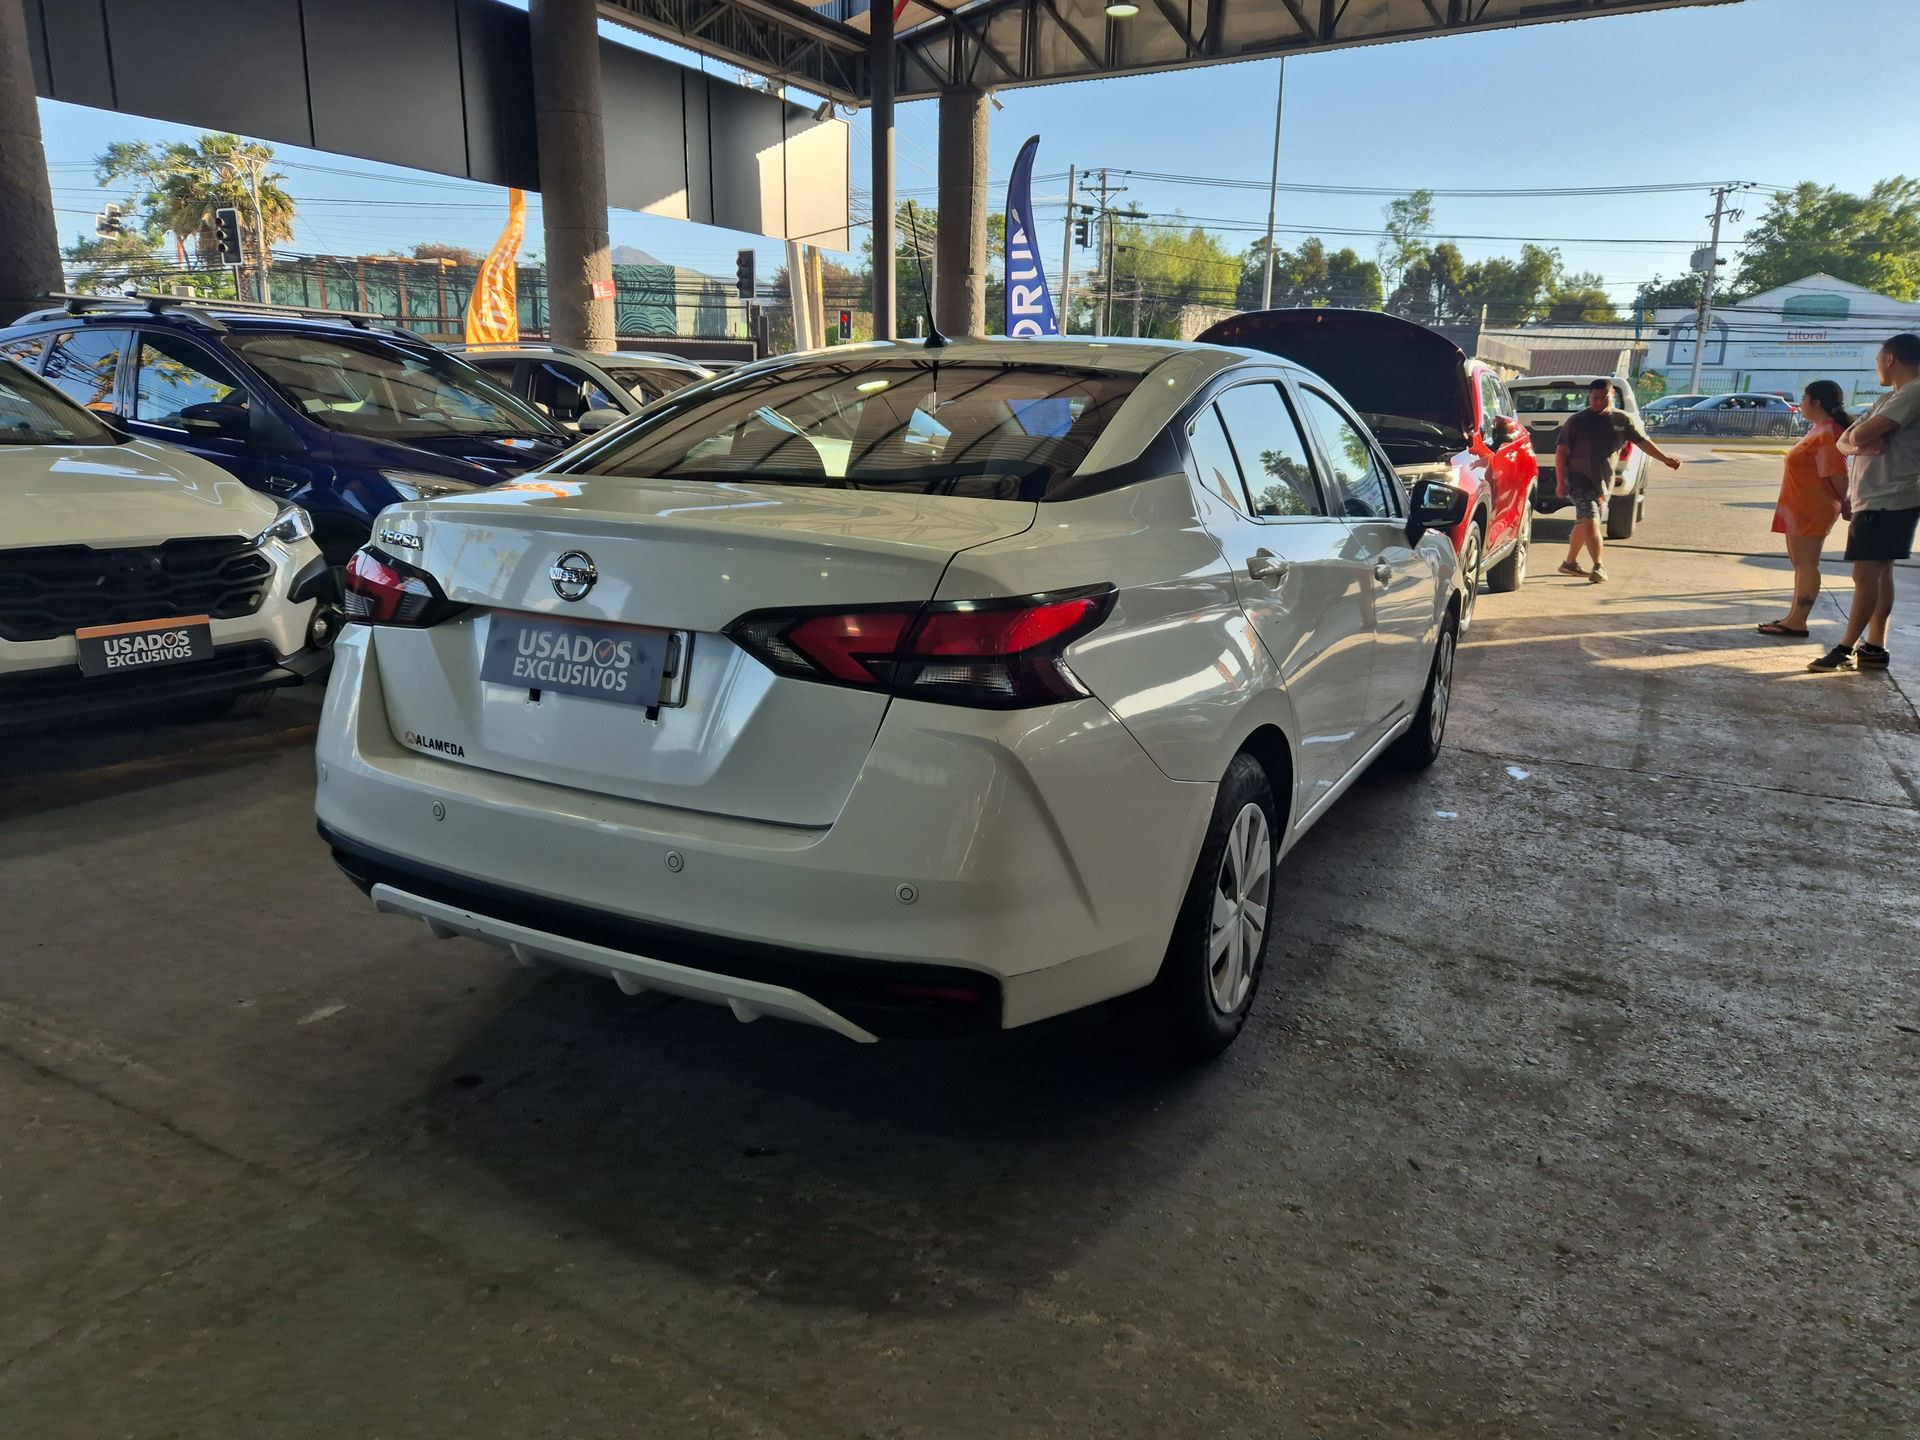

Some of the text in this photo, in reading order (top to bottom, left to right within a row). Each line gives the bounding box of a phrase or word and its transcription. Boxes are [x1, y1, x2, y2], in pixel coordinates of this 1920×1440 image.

[1787, 331, 1828, 341] Litoral
[379, 529, 423, 551] VERSA
[552, 568, 590, 582] NISSAN
[104, 630, 190, 656] USADOS
[518, 628, 632, 669] USADOS
[106, 646, 192, 668] EXCLUSIVOS
[512, 657, 628, 692] EXCLUSIVOS
[416, 734, 465, 758] ALAMEDA
